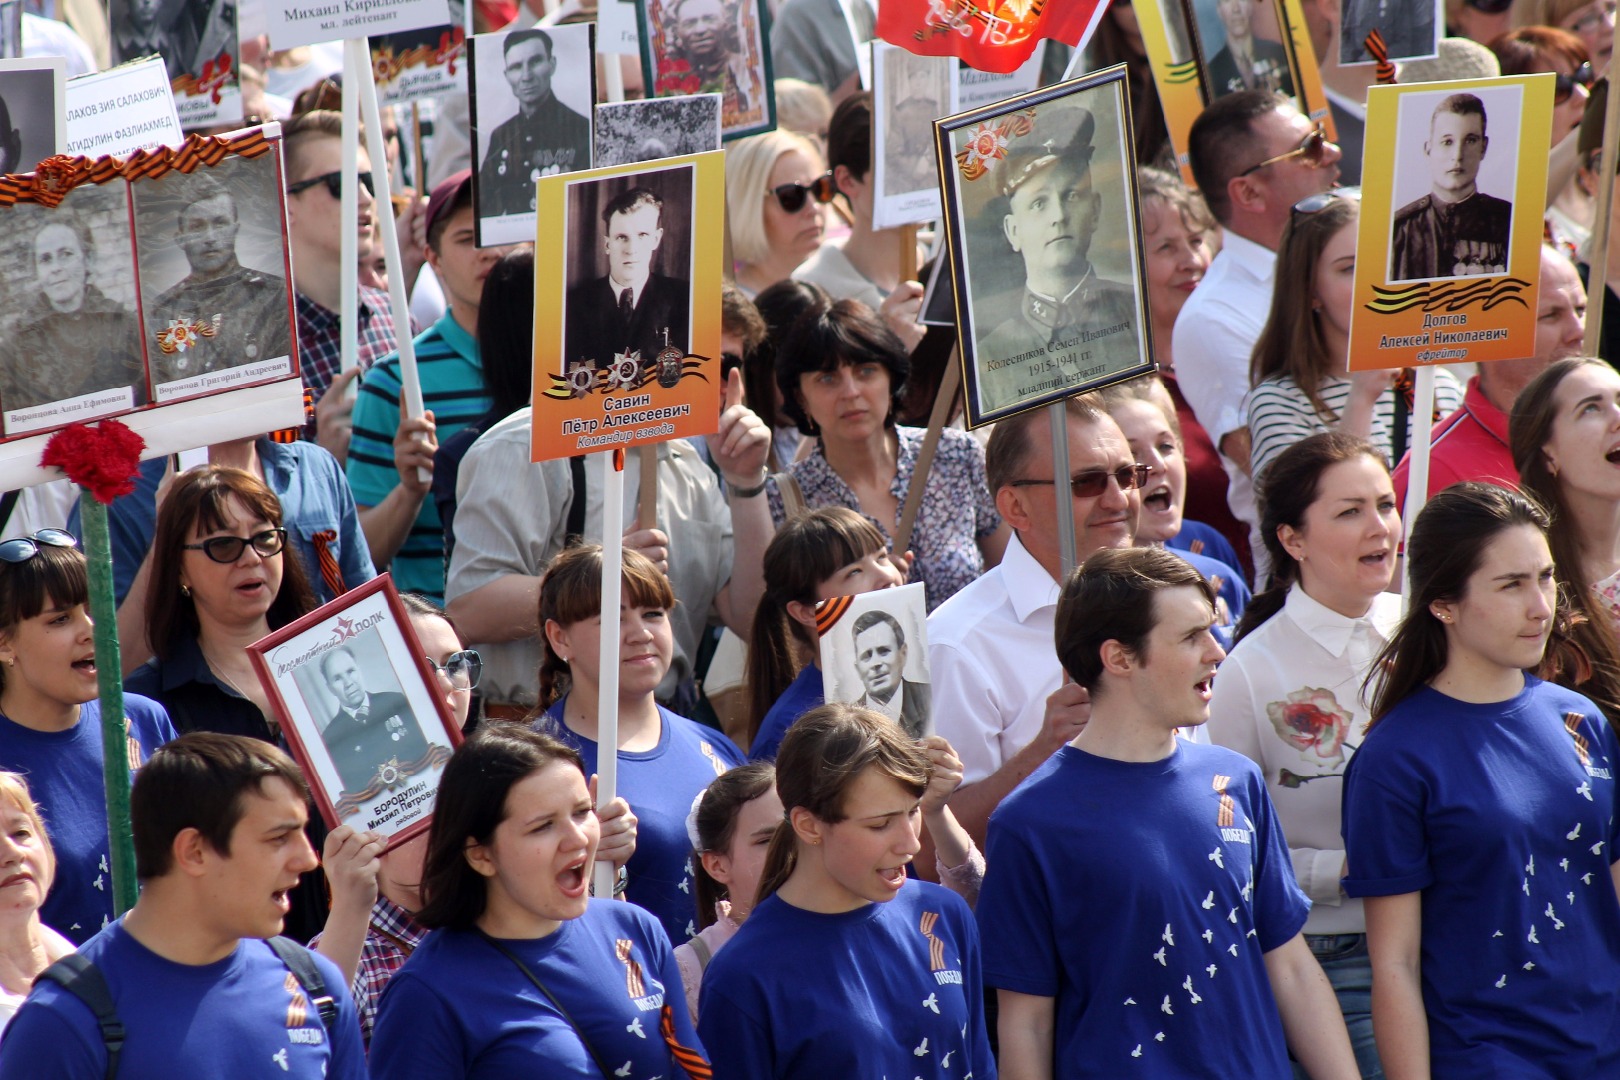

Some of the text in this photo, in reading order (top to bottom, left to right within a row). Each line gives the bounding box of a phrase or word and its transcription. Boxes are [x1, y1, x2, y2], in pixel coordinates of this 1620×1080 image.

[284, 5, 340, 22] Михаил
[320, 11, 398, 30] мл. лейтенант
[99, 99, 116, 113] ЗИЯ
[116, 86, 167, 108] САЛАХОВИЧ
[114, 115, 173, 140] ФАЗЛИАХМЕД
[1422, 312, 1468, 329] Долгов
[986, 321, 1131, 372] Колесников Семен Иванович
[1379, 328, 1508, 349] Алексей Николаевич
[1028, 352, 1078, 377] 1915-1941
[1416, 347, 1468, 362] ефрейтор
[200, 370, 242, 387] Григорий
[242, 362, 288, 378] Андреевич
[1017, 362, 1107, 397] младший сержант
[10, 393, 127, 424] Воронцова Анна Ефимовна
[603, 393, 650, 412] Савин
[562, 403, 690, 436] Пётр Алексеевич
[576, 422, 674, 449] Командир взвода
[354, 611, 386, 634] ПОЛК
[373, 781, 427, 816] БОРОДУЛИН
[367, 808, 400, 830] Михаил
[395, 808, 422, 827] рядовой
